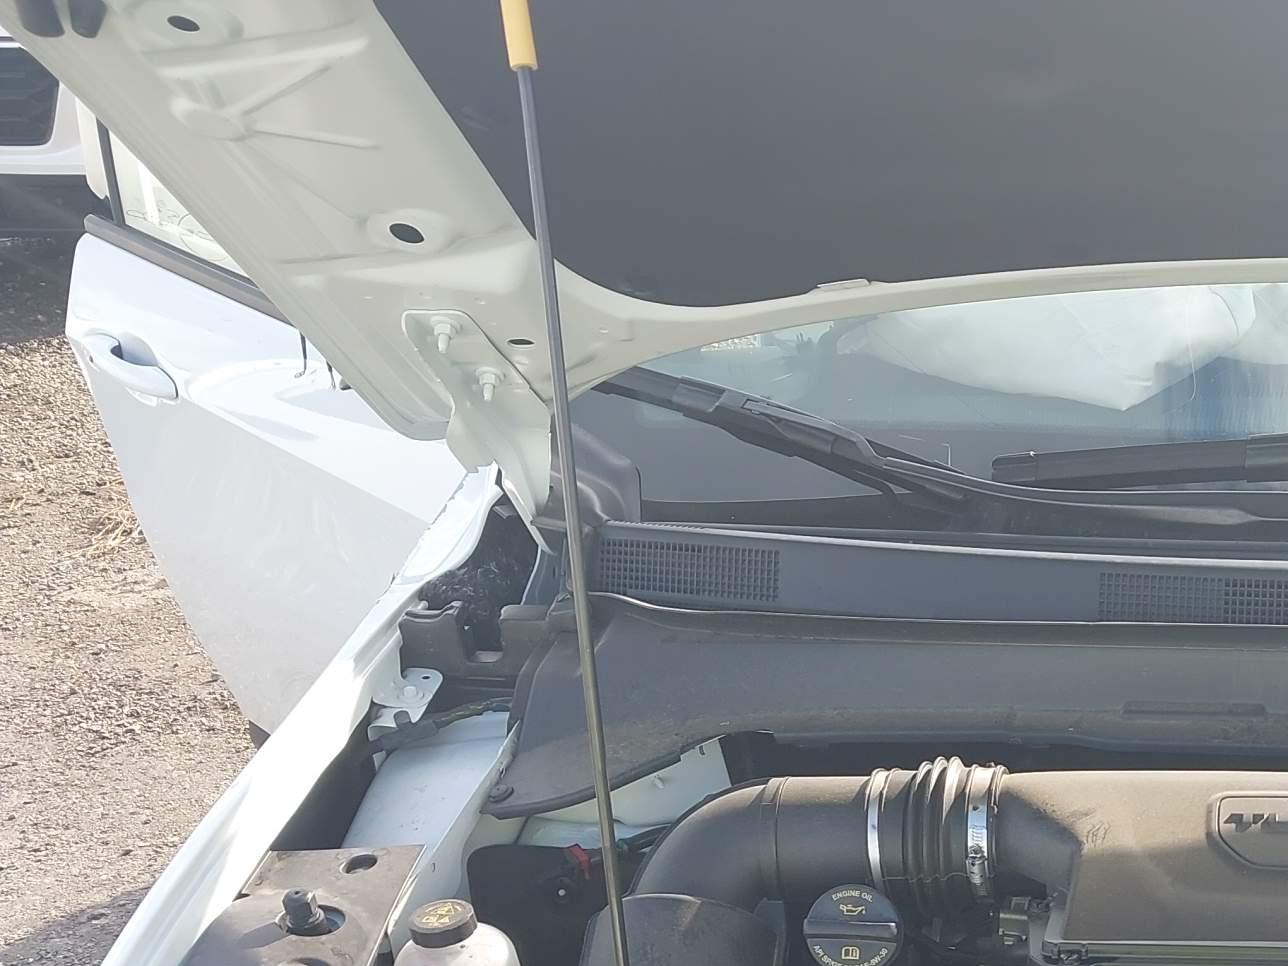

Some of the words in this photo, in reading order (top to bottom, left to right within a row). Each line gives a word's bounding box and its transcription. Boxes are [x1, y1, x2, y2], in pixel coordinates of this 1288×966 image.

[831, 890, 861, 902] ENGINE
[861, 892, 873, 903] OIL
[813, 945, 824, 957] API
